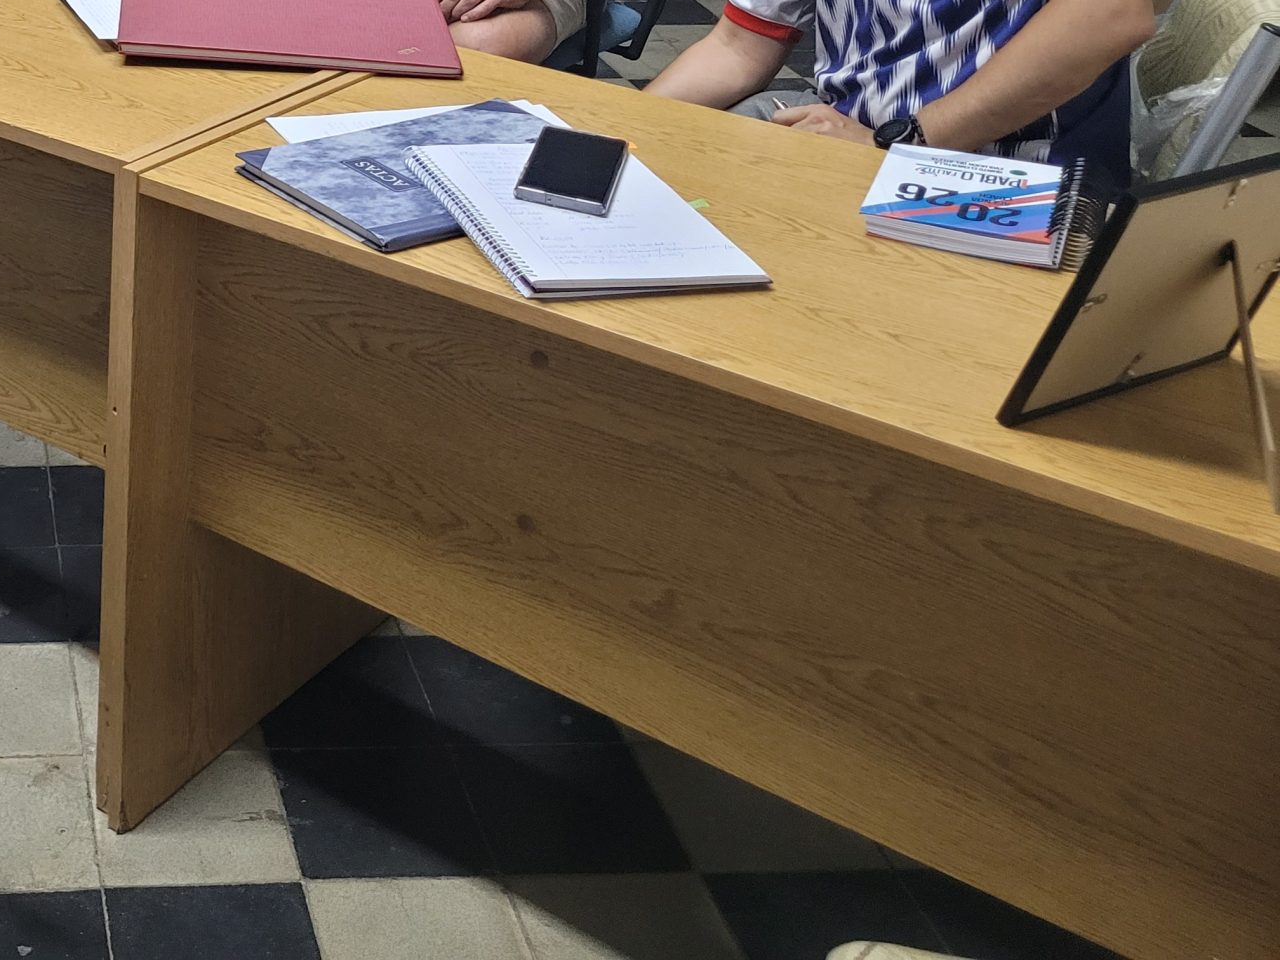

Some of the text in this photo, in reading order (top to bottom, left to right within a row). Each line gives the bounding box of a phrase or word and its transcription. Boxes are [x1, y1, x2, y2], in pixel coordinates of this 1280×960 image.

[354, 161, 410, 186] ACTAS
[959, 171, 1022, 188] PABLO
[894, 181, 959, 207] 26
[957, 203, 1022, 227] 20
